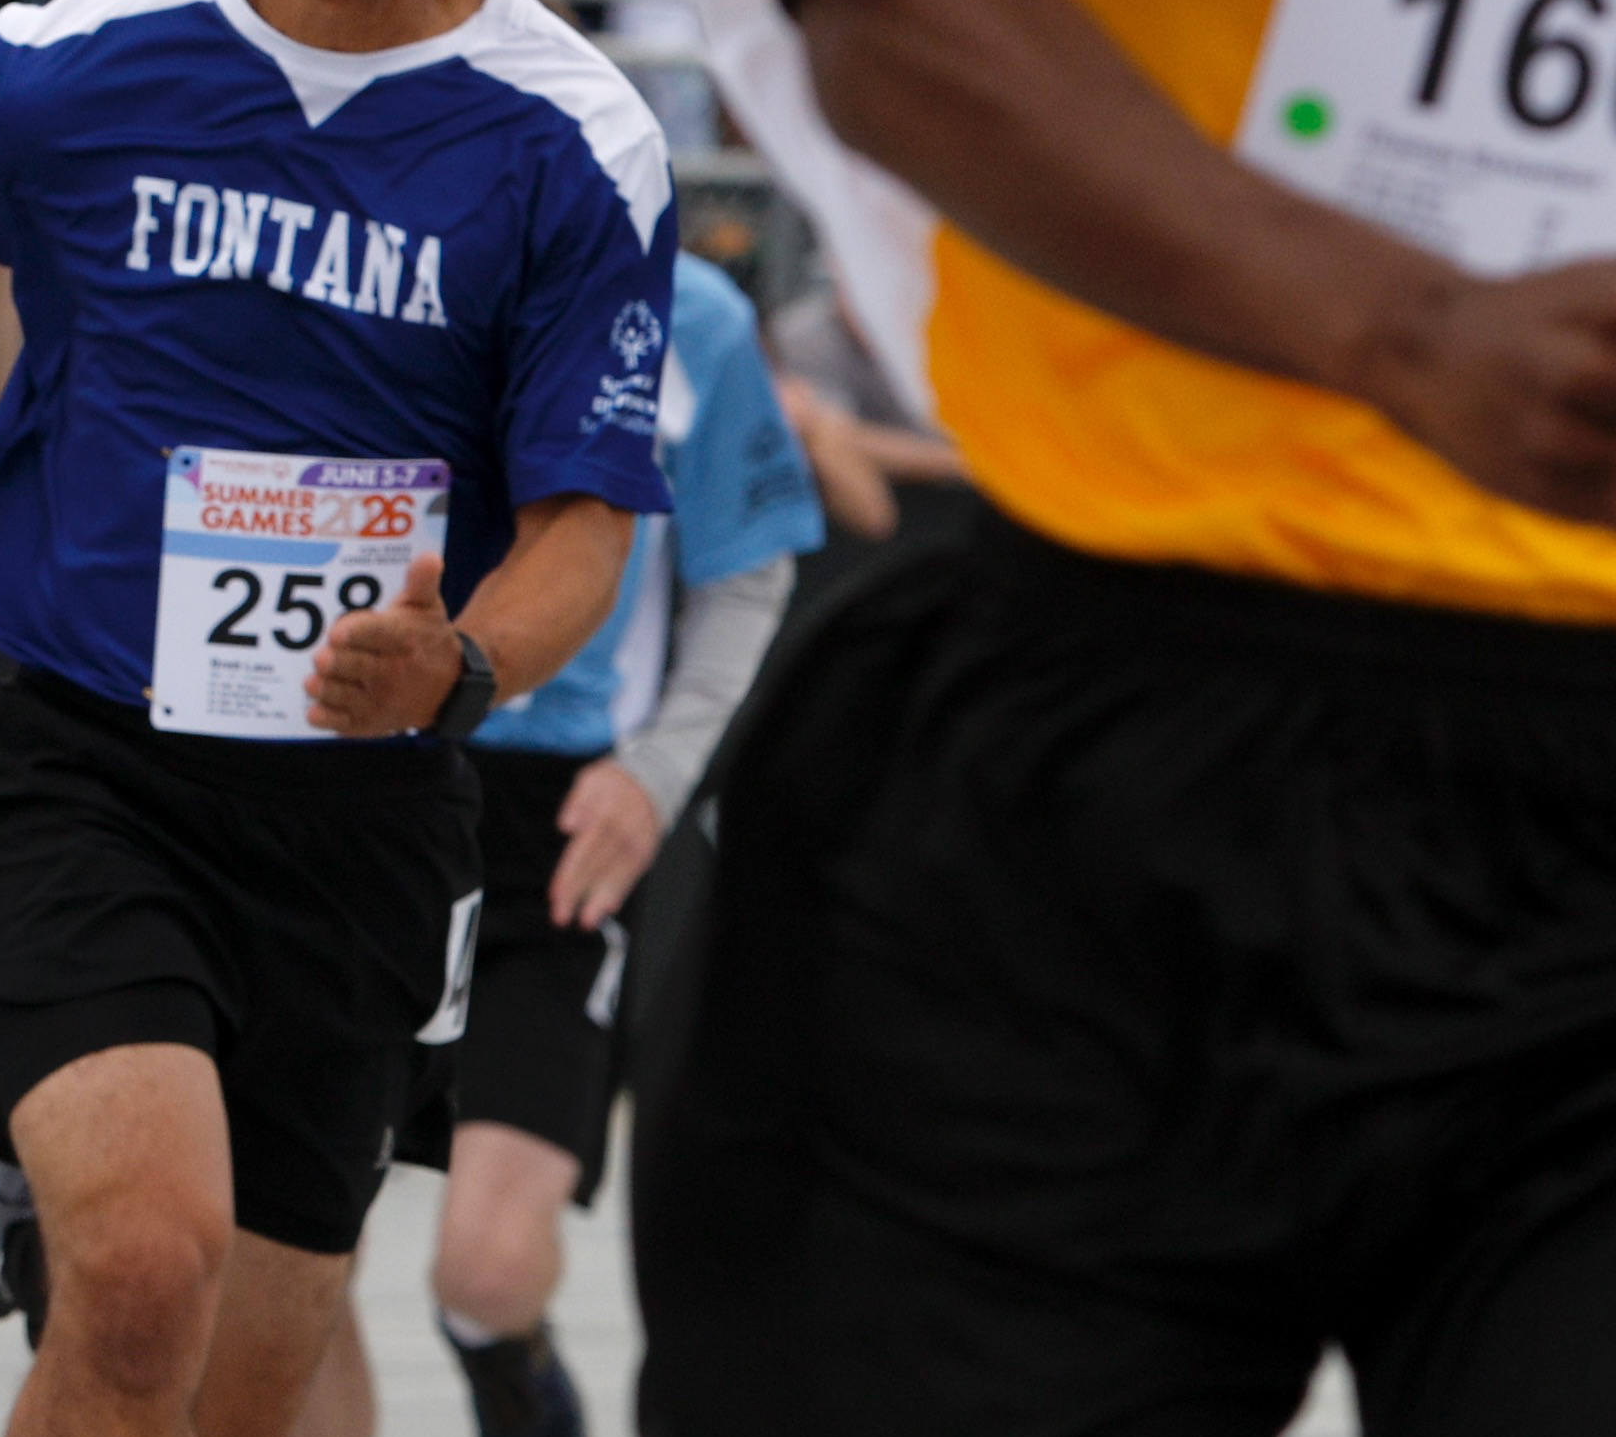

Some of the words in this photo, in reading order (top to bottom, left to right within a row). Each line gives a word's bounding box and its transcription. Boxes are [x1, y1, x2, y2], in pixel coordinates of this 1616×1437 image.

[125, 175, 448, 327] FONTANA
[319, 463, 375, 486] JUNE
[201, 483, 314, 509] SUMMER
[200, 506, 313, 537] GAMES
